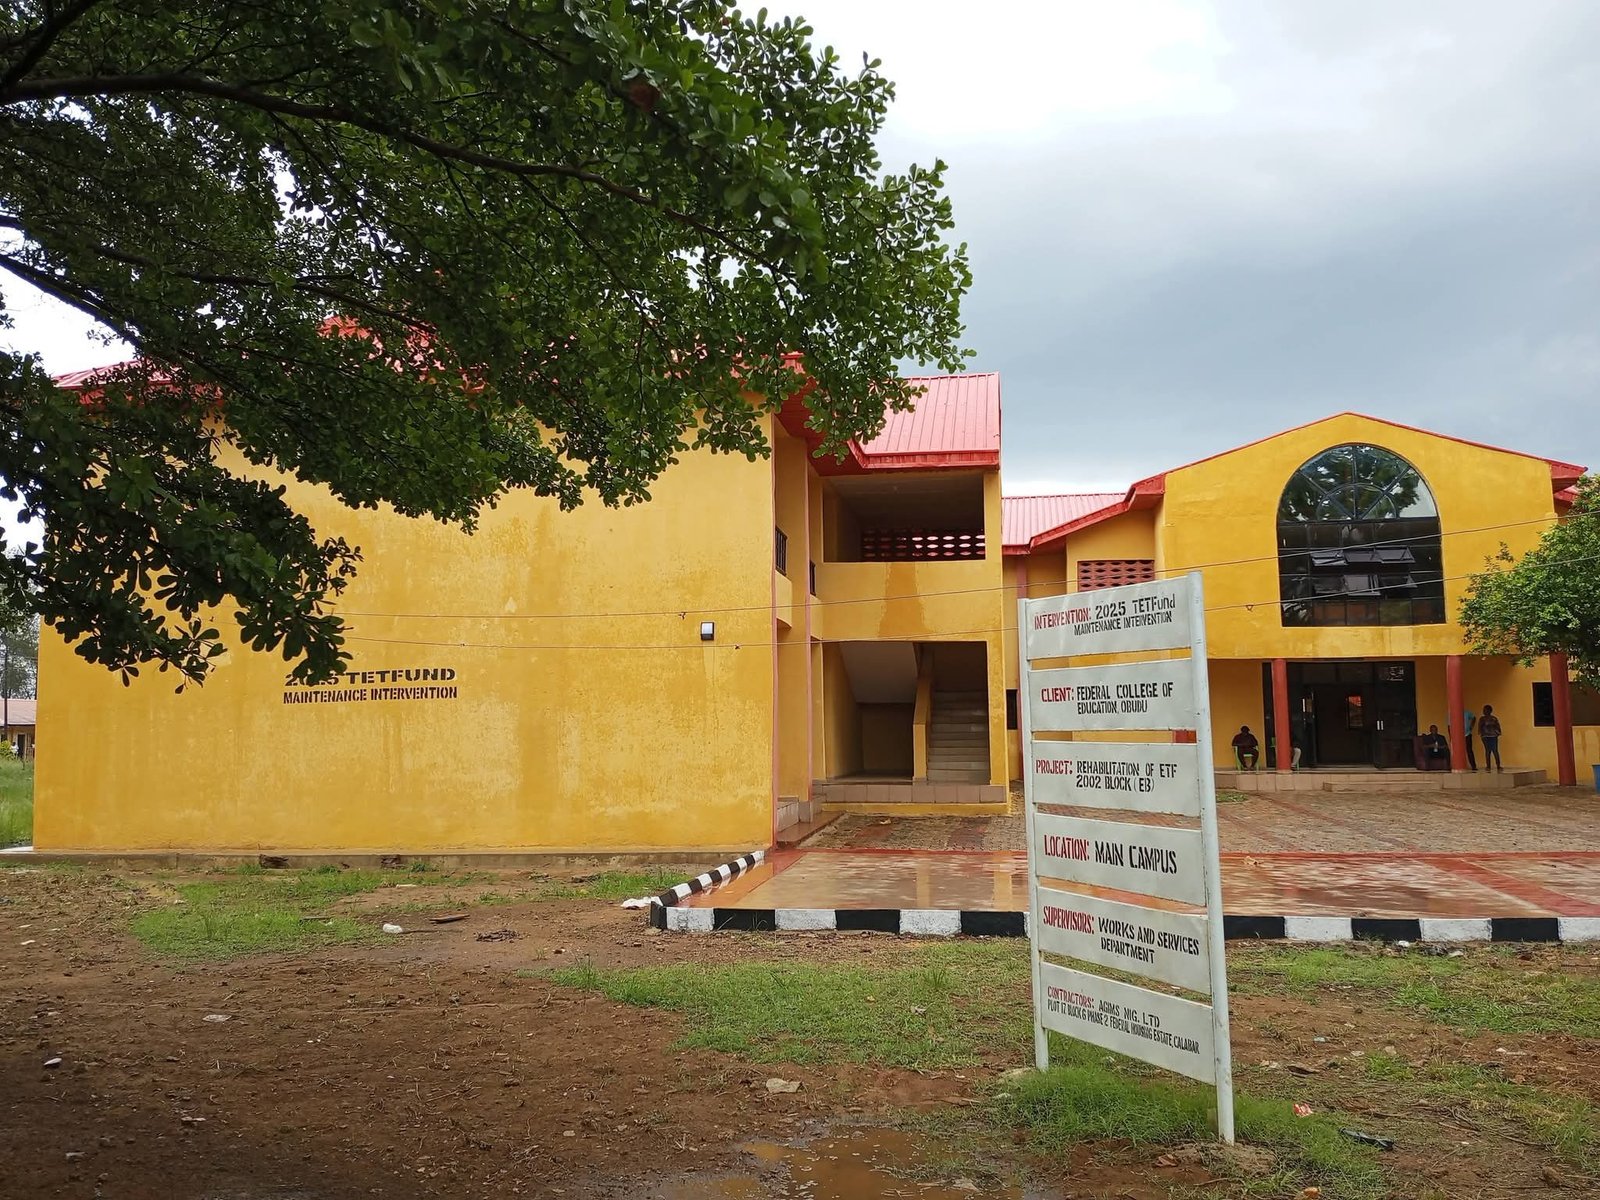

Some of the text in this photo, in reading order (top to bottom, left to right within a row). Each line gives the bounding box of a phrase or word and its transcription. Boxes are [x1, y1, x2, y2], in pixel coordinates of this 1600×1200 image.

[1034, 593, 1176, 630] INTERVENTION: 2025 TETFund
[1074, 611, 1172, 636] MAINTENANCE INTERVENTION
[346, 668, 456, 685] TETFUND
[283, 686, 457, 704] MAINTENANCE INTERVENTION
[1041, 682, 1174, 702] CLIENT: FEDERAL COLLEGE OF
[1121, 699, 1147, 713] OBUDU
[1036, 759, 1178, 778] PROJECT: REHABILITATION OF ETF
[1076, 775, 1101, 789] 2002
[1105, 775, 1132, 791] BLOCK
[1043, 834, 1178, 874] LOCATION: MAIN CAMPUS
[1043, 906, 1200, 956] SUPERVISORS: WORKS AND SERVICES
[1101, 937, 1155, 964] DEPARTMENT
[1047, 986, 1160, 1028] CONTRACTORS: AGIMS NIG. LTD
[1047, 998, 1060, 1013] PLOT
[1068, 1004, 1081, 1019] BLOCK
[1087, 1009, 1103, 1026] PHASE
[1104, 1014, 1109, 1027] 2
[1110, 1016, 1130, 1034] FEDERAL
[1131, 1022, 1153, 1040] HOUSING
[1174, 1036, 1200, 1055] CALABAR
